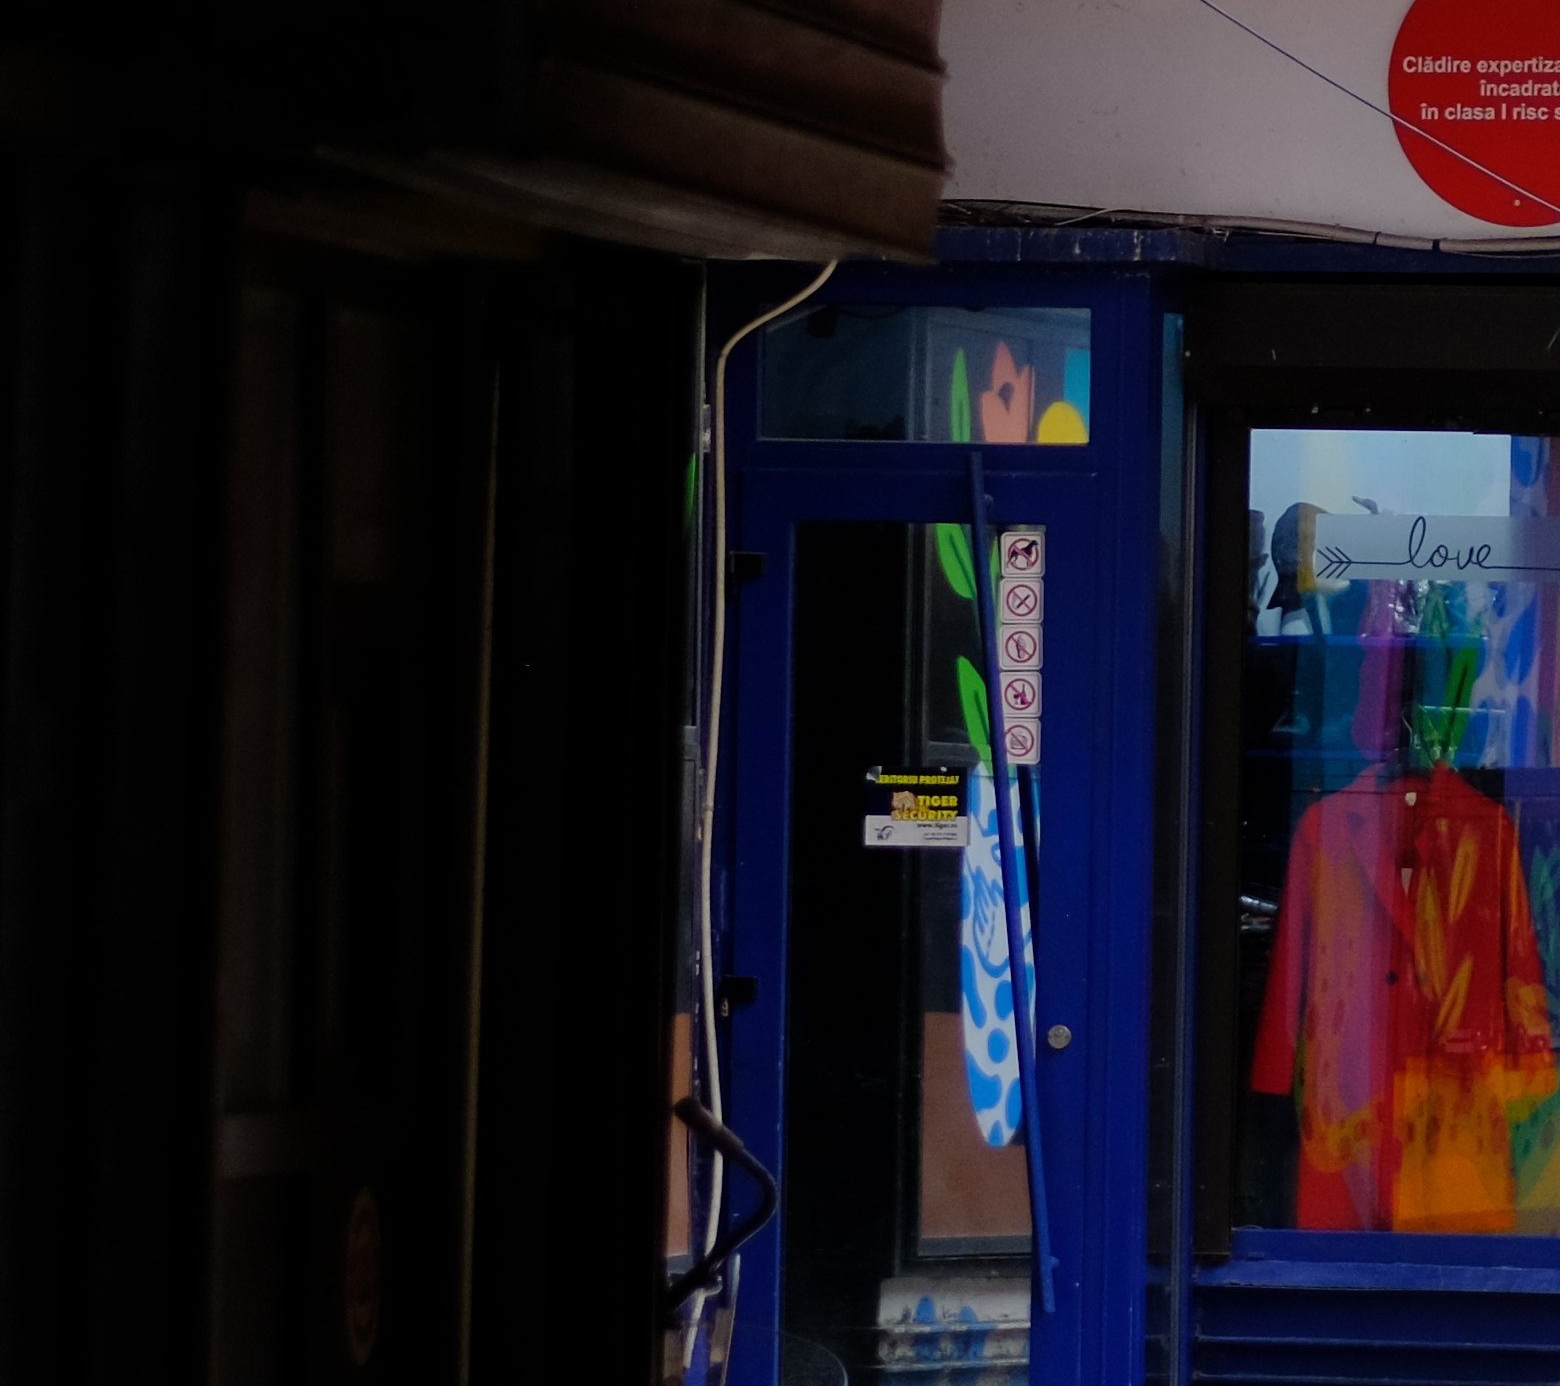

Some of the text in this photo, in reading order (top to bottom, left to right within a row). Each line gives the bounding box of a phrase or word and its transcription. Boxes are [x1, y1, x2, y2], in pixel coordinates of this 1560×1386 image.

[1402, 55, 1471, 74] Clădire
[1421, 104, 1439, 120] în
[1444, 103, 1496, 120] clasa
[1501, 104, 1507, 119] I
[1513, 103, 1548, 120] risc
[1408, 516, 1491, 569] love
[917, 795, 958, 807] TIGER
[893, 809, 958, 821] SECURITY
